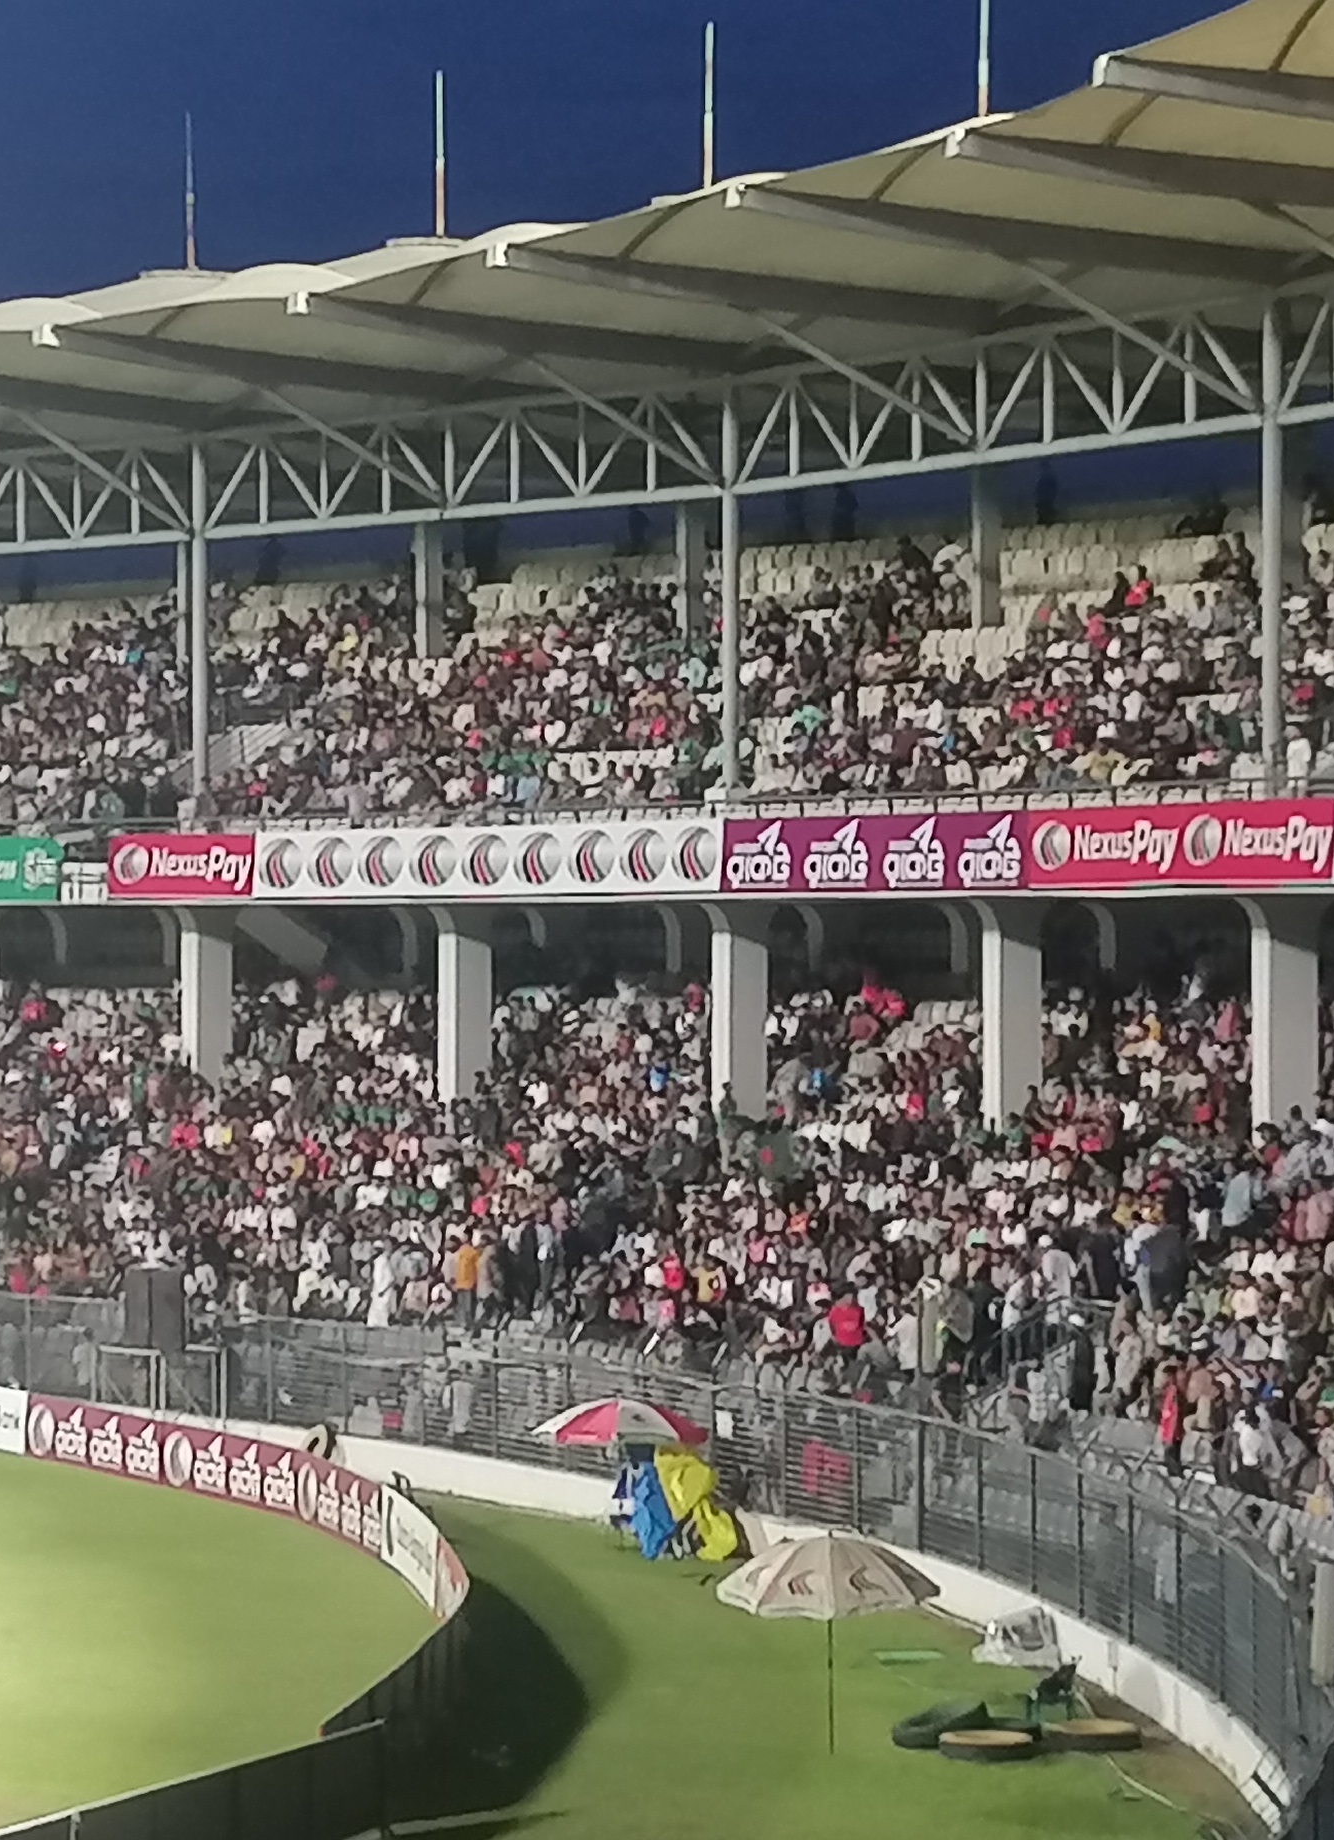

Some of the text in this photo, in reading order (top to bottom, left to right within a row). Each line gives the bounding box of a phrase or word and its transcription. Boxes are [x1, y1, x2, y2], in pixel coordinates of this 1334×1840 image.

[149, 846, 251, 892] NexusPay
[1074, 816, 1333, 874] NexusPay NexusPay
